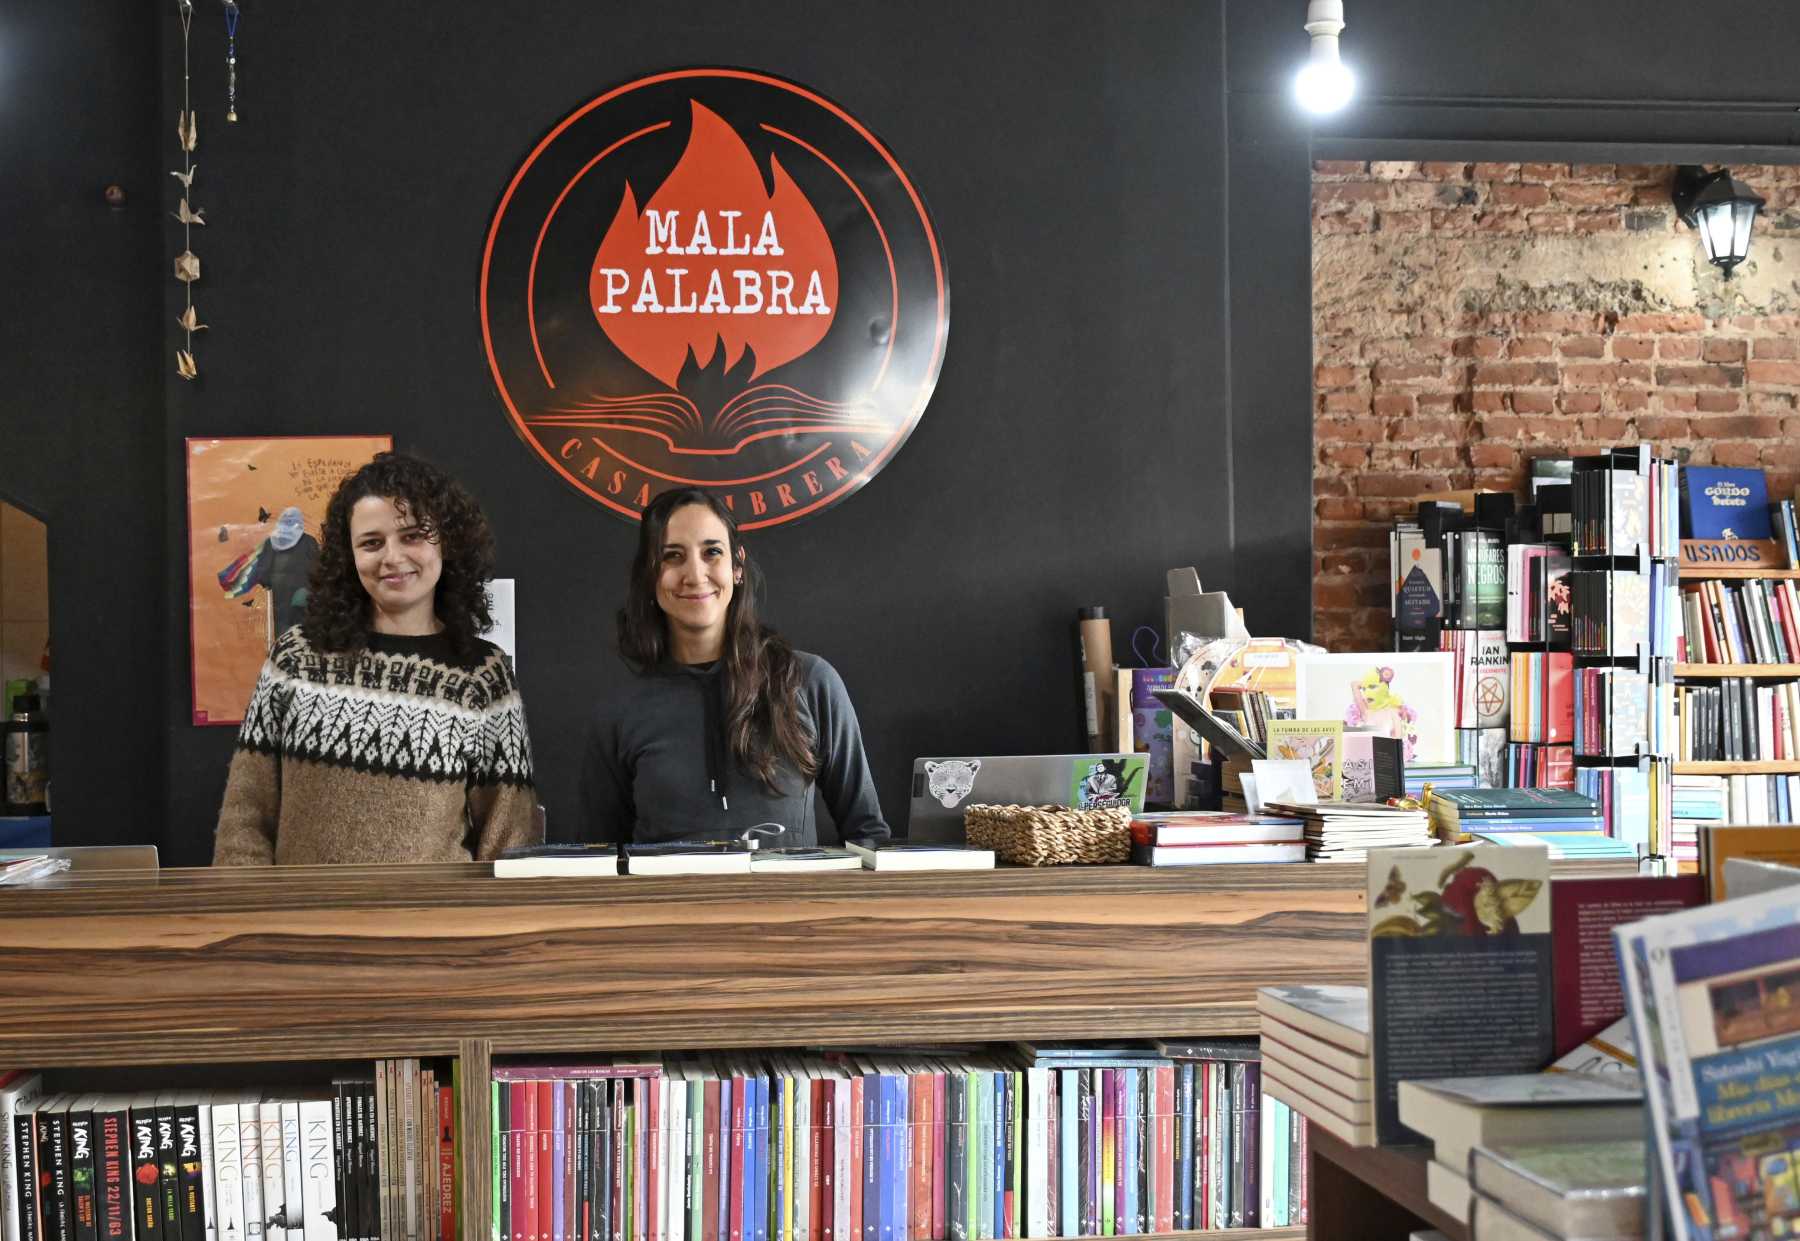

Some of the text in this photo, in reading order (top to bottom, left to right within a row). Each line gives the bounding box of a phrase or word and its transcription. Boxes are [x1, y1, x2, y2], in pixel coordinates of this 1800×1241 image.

[645, 210, 784, 255] MALA
[598, 268, 831, 314] PALABRA
[561, 438, 649, 507] CASA
[1467, 564, 1505, 585] NEGROS
[1684, 544, 1761, 562] USADOS
[1470, 656, 1509, 666] RANKIN
[1482, 646, 1500, 655] IAN
[21, 1122, 31, 1168] STEPHEN
[52, 1120, 62, 1166] STEPHEN
[73, 1127, 91, 1159] KING
[137, 1126, 155, 1159] KING
[159, 1122, 173, 1149] KING
[180, 1123, 197, 1157] KING
[217, 1123, 238, 1181] KING
[240, 1120, 260, 1179] KING
[263, 1121, 281, 1179] KING
[285, 1119, 298, 1162] KING
[308, 1120, 329, 1179] KING
[24, 1172, 32, 1198] KING
[56, 1170, 64, 1195] KING
[104, 1118, 122, 1236] STEPHEN KING 22/11/63
[441, 1163, 451, 1214] AJEDREZ
